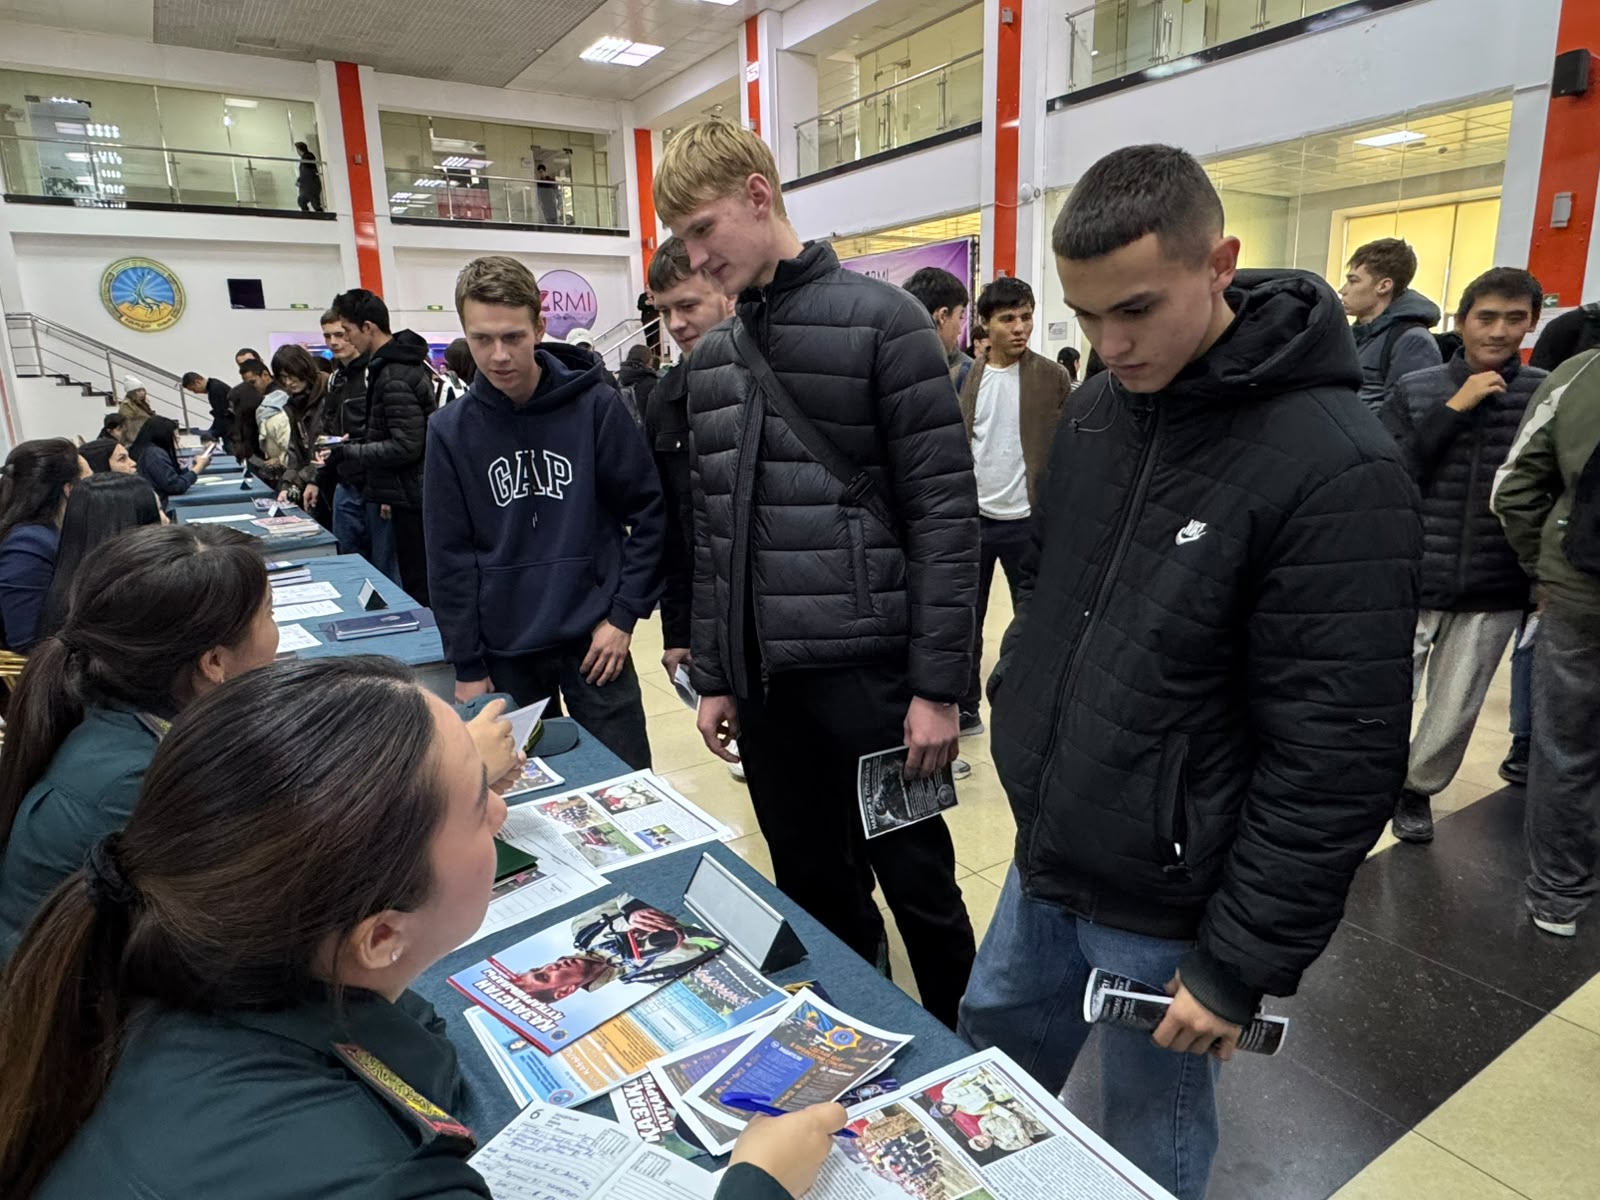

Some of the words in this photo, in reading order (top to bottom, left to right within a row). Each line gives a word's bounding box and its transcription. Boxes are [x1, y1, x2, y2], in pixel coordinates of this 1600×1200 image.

[488, 449, 572, 507] GAP
[473, 979, 557, 1033] ҚАЗАҚСТАН
[529, 1108, 545, 1120] 6
